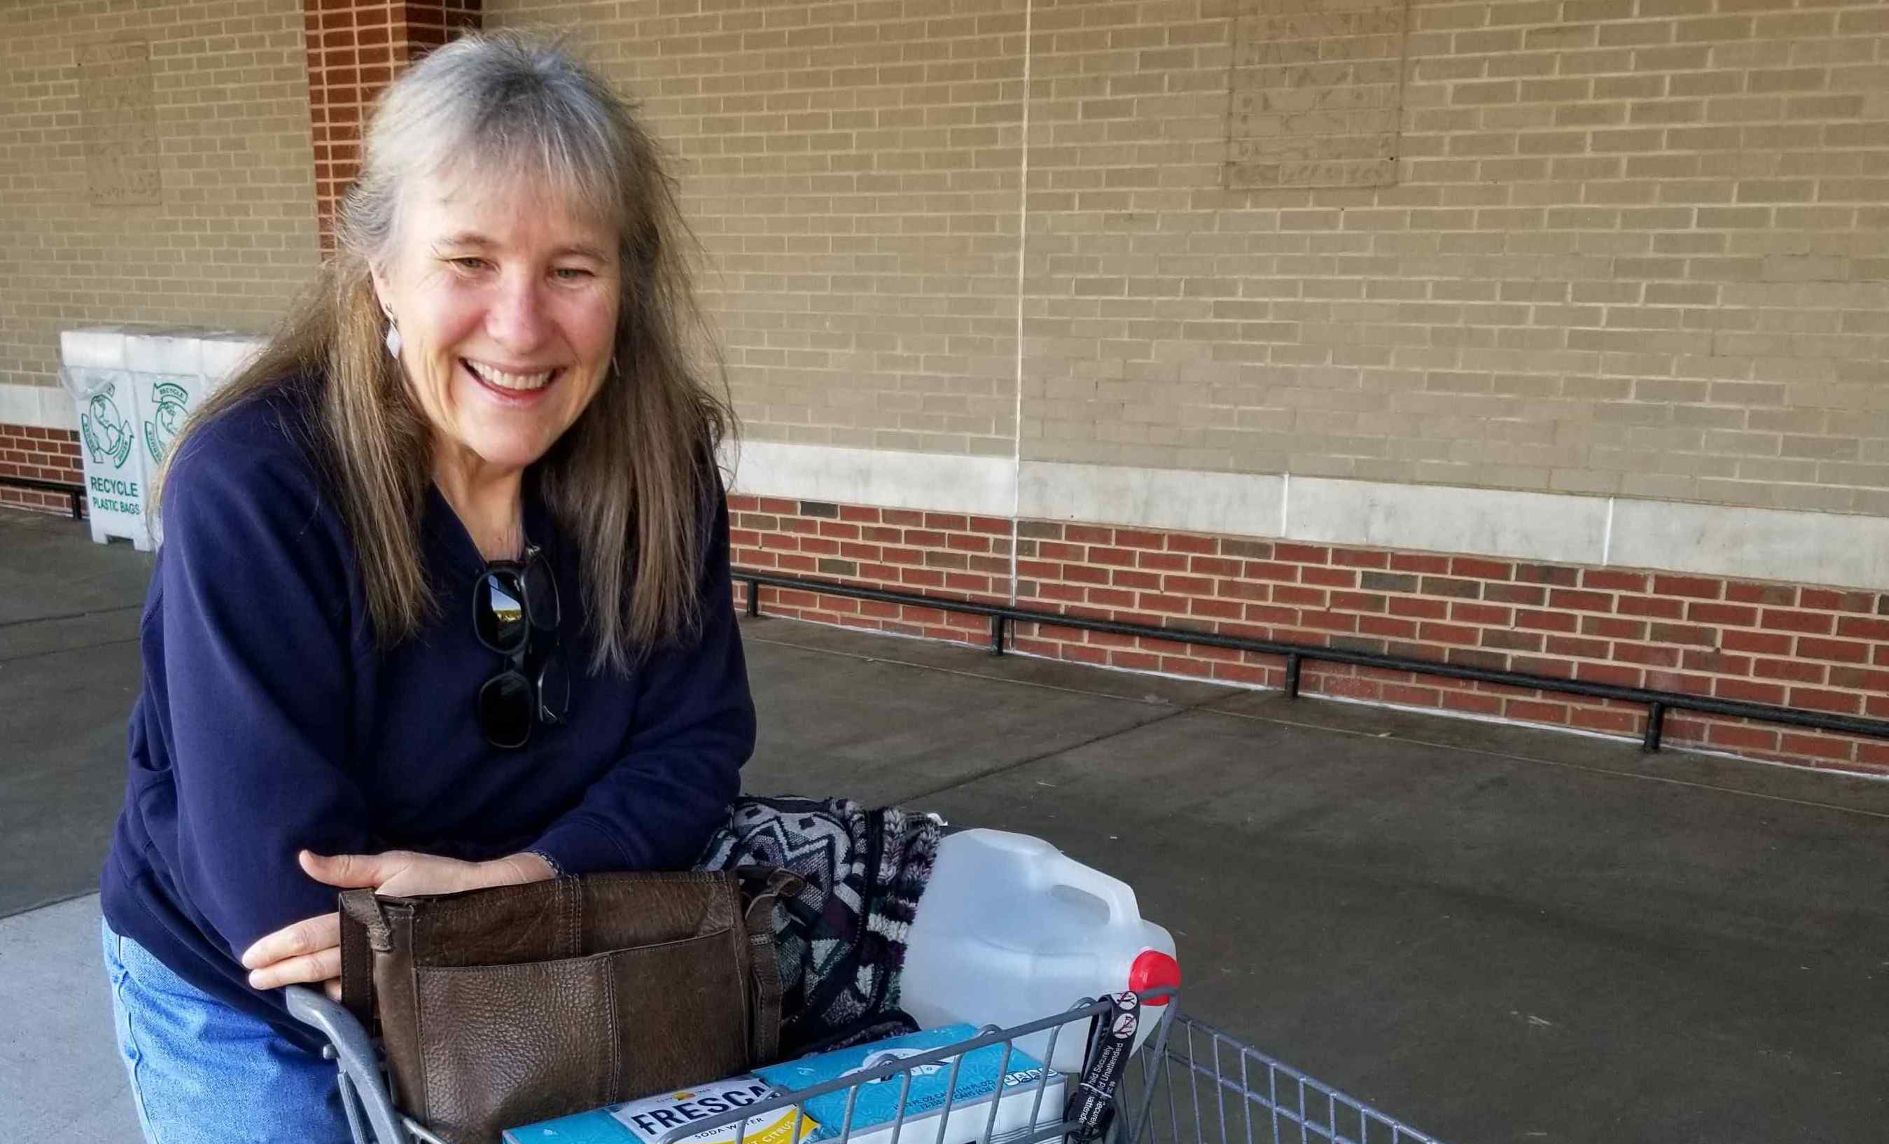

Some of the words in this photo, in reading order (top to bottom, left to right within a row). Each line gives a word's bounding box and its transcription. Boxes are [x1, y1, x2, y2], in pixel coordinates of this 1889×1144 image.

[90, 476, 139, 498] RECYCLE
[92, 497, 119, 512] PLASTIC
[120, 501, 140, 515] BAGS
[631, 1078, 772, 1136] FRESCA
[695, 1128, 724, 1140] SODA
